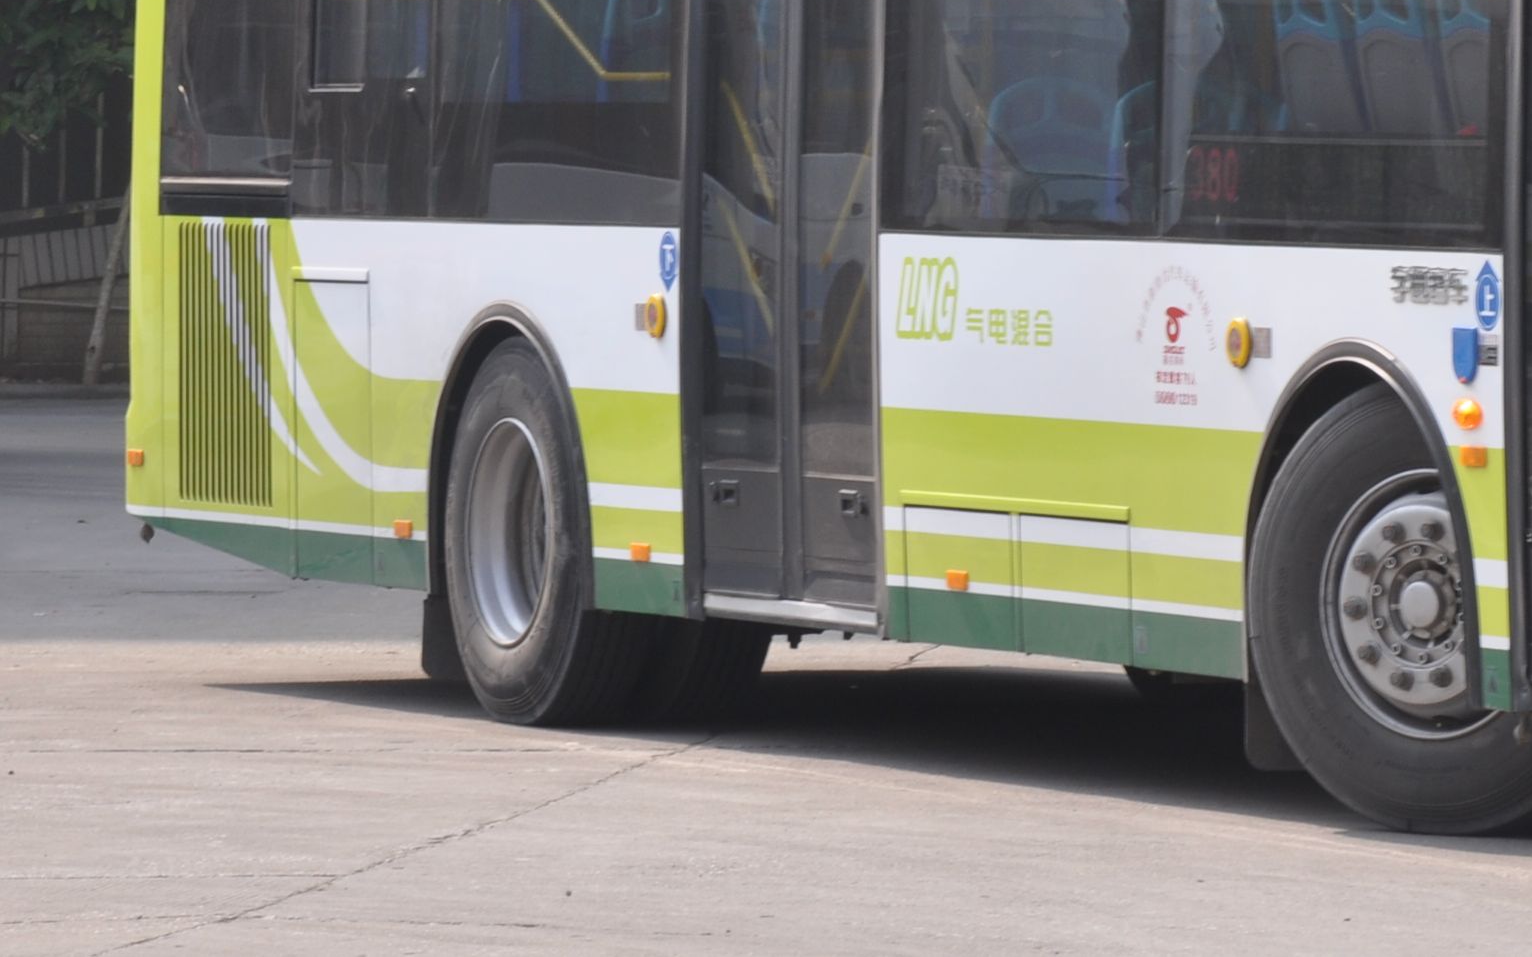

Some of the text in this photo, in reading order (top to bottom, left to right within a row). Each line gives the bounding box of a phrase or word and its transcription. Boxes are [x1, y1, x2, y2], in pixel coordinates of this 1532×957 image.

[896, 256, 960, 342] LNG
[966, 307, 1053, 347] 气电混合
